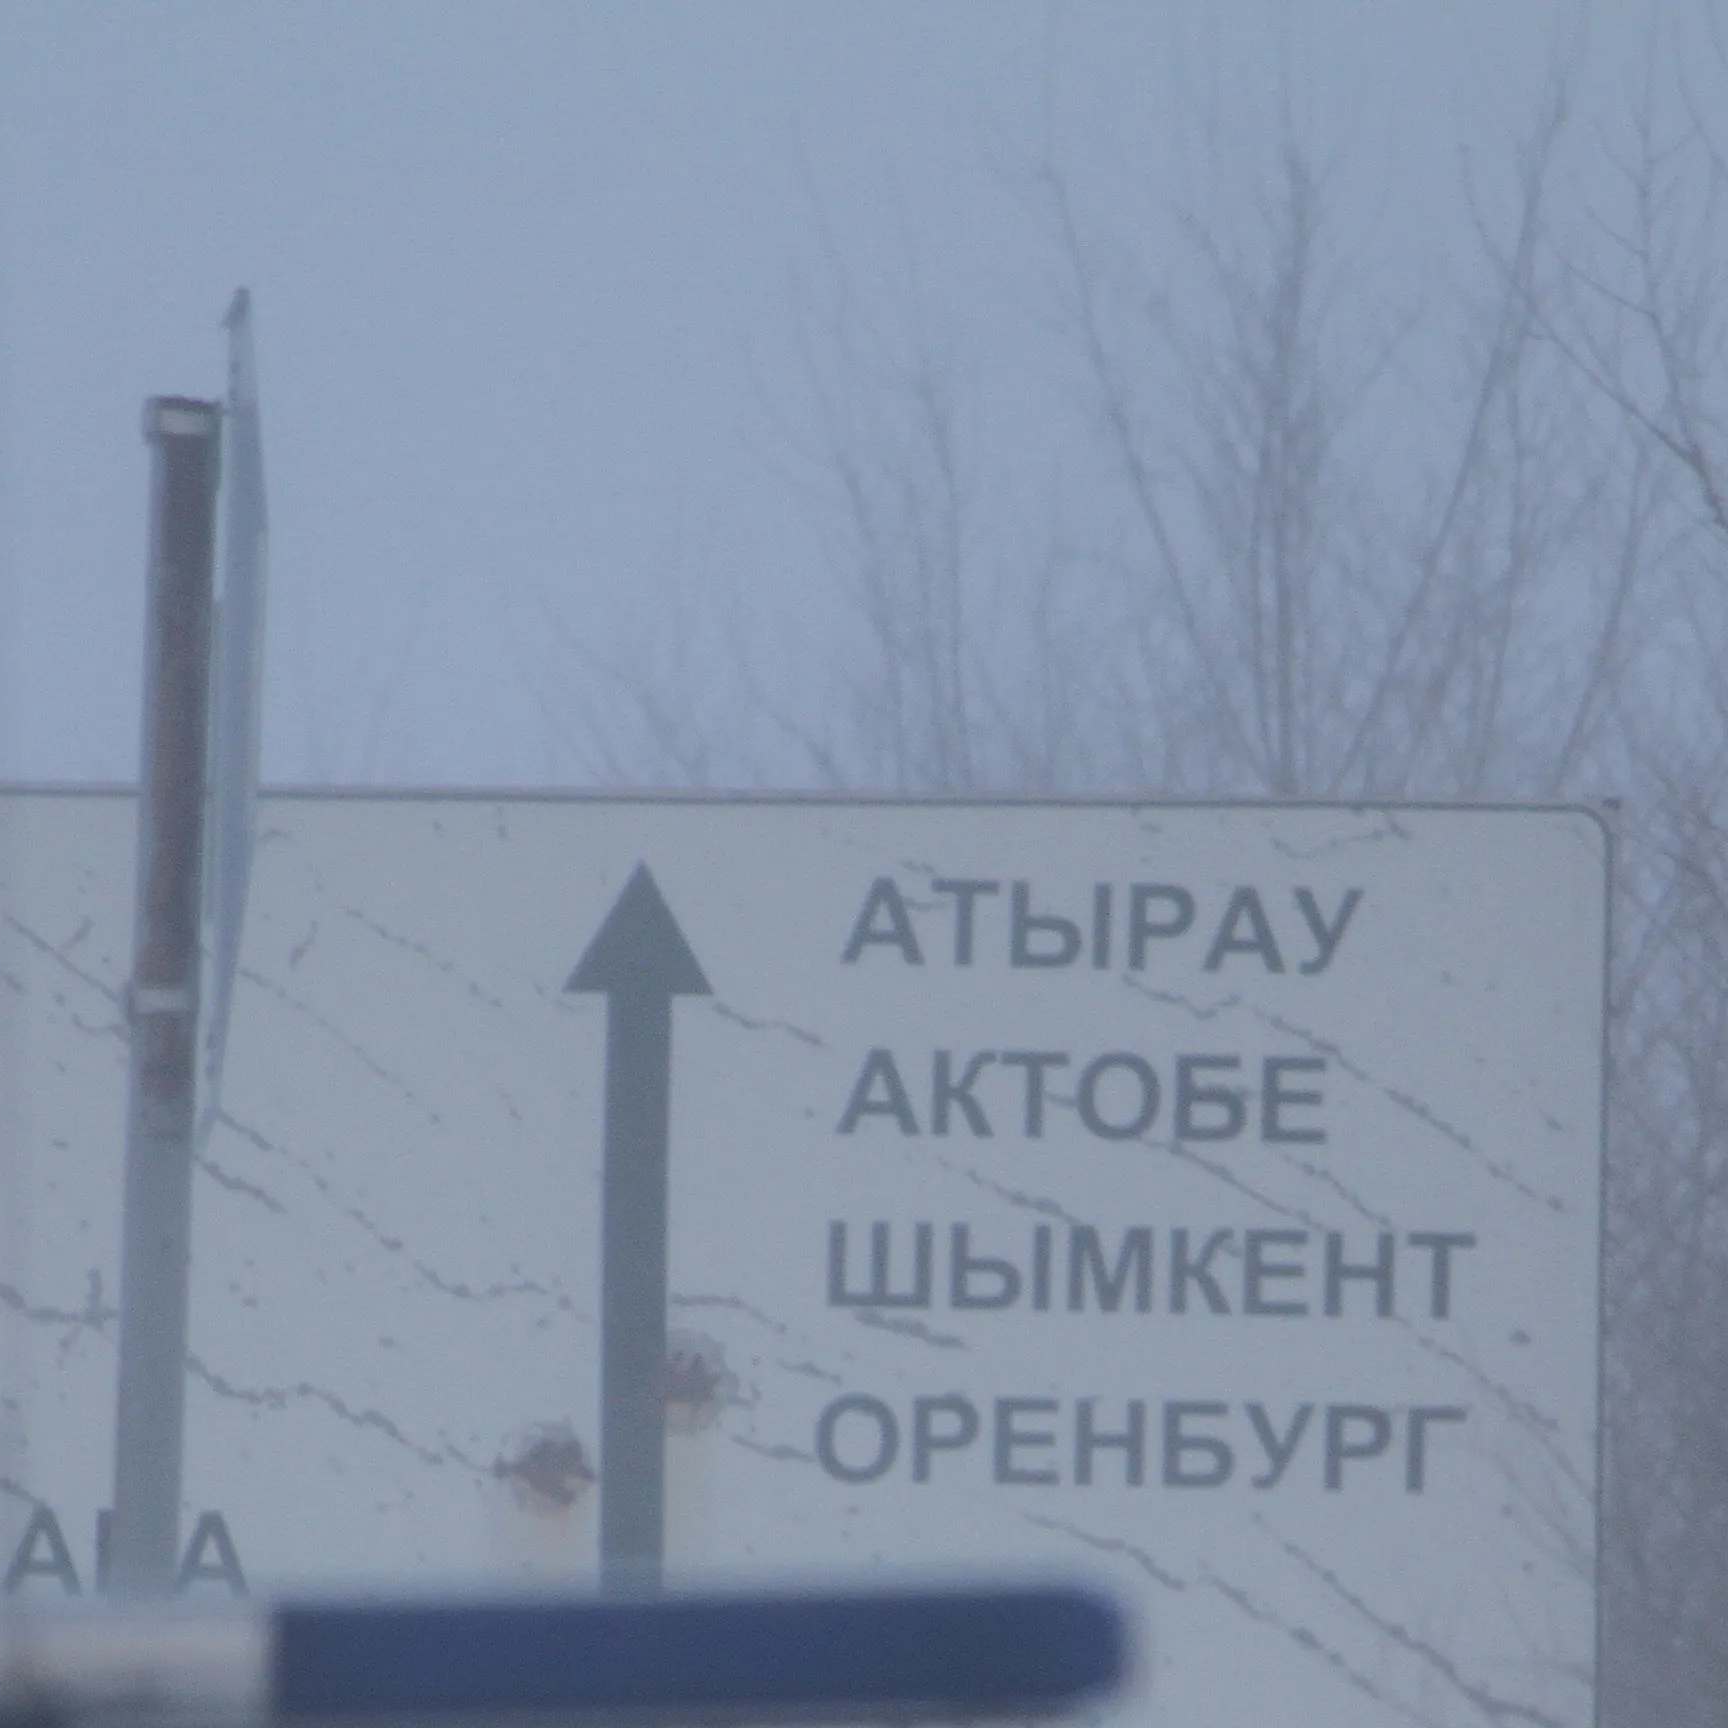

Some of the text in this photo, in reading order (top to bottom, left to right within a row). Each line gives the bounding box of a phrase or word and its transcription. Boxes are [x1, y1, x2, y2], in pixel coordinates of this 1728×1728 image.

[840, 877, 1365, 976] АТЫРАУ
[835, 1048, 1328, 1145] АКТОБЕ
[826, 1219, 1478, 1321] ШЫМКЕНТ
[814, 1394, 1468, 1495] ОРЕНБУРГ
